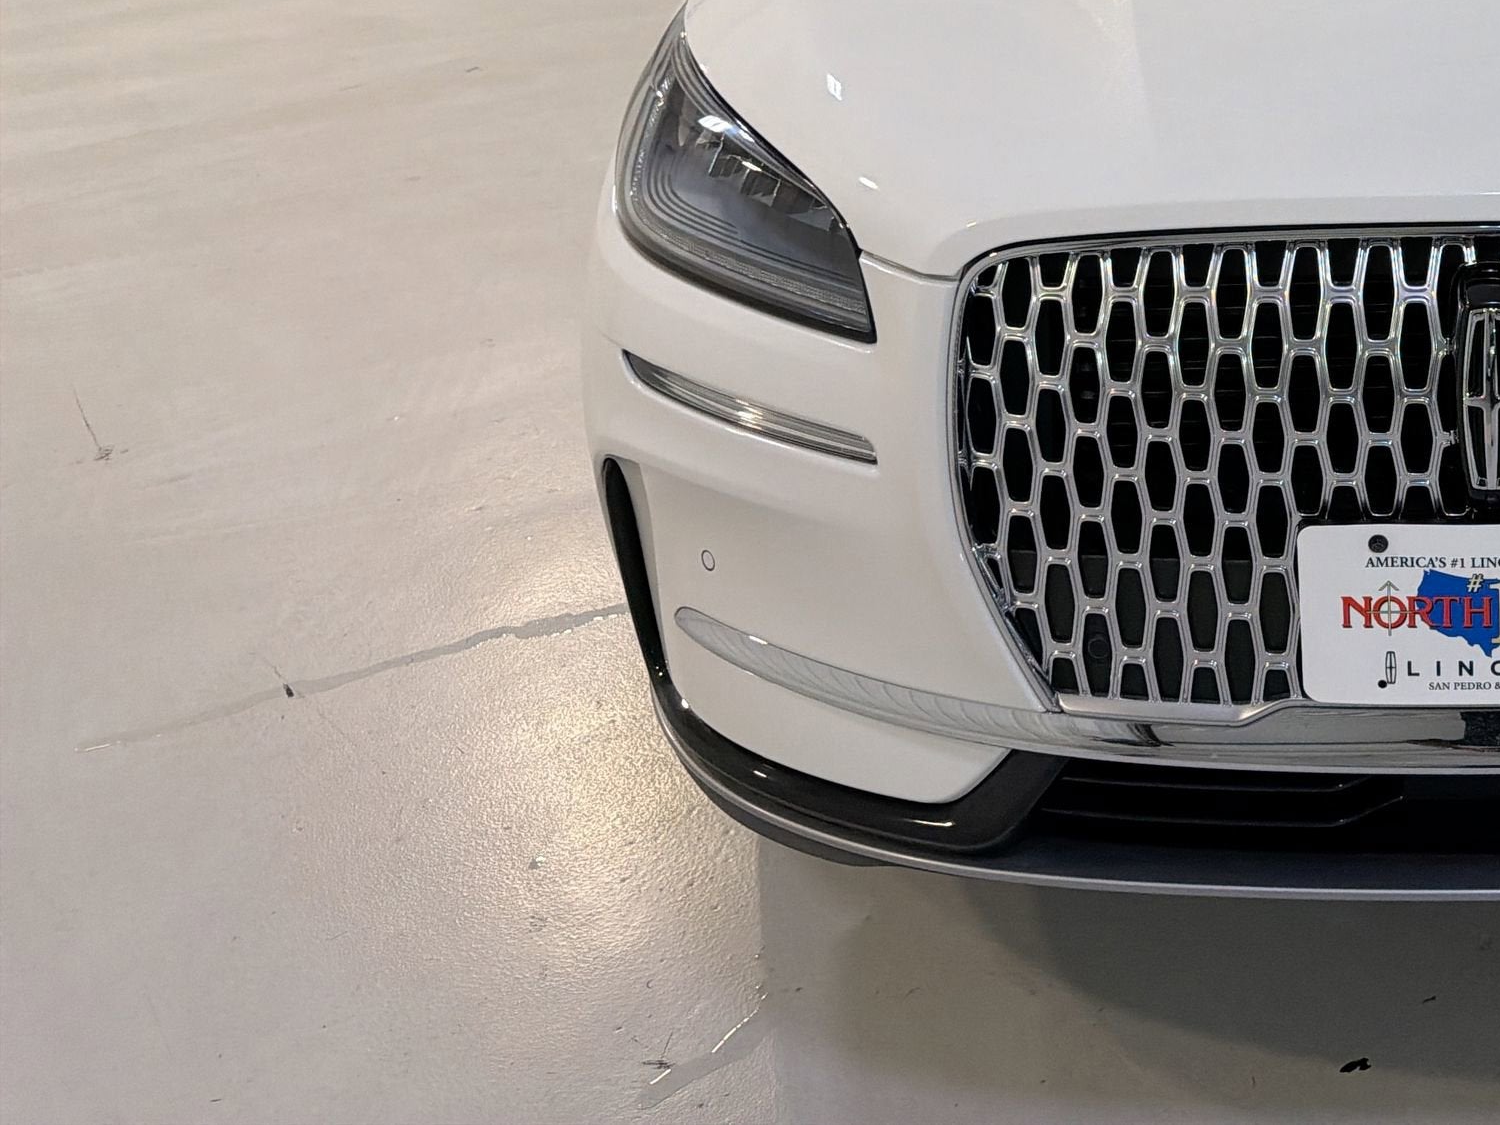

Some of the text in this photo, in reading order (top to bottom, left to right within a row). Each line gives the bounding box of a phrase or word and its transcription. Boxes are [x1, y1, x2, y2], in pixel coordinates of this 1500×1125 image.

[1365, 556, 1447, 569] AMERICA'S
[1450, 558, 1466, 569] #1
[1341, 595, 1493, 630] NORTH
[1428, 681, 1451, 691] SAN
[1453, 681, 1492, 691] PEDRO
